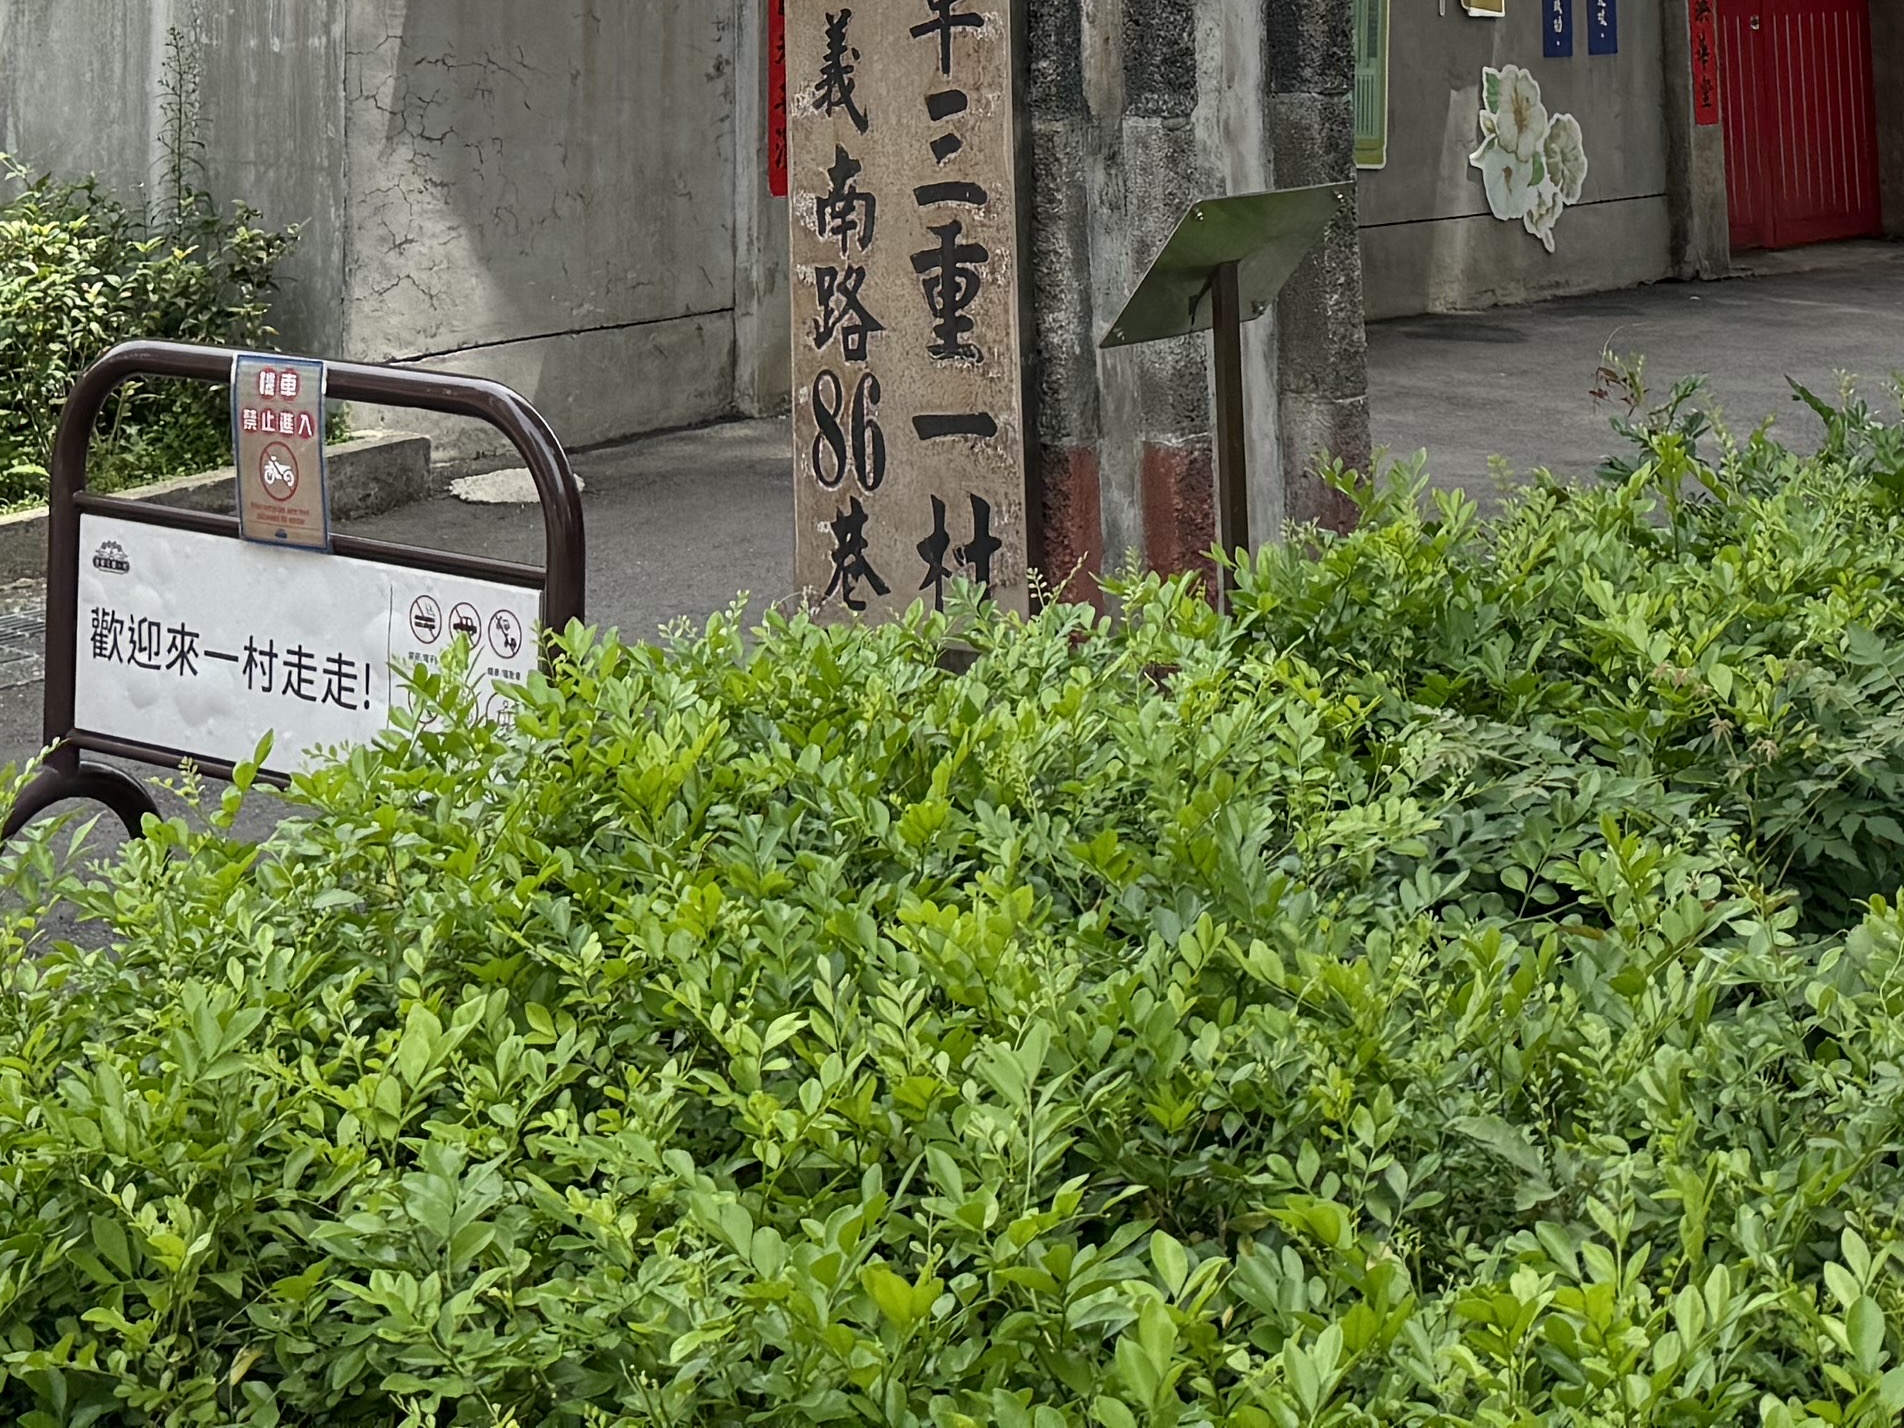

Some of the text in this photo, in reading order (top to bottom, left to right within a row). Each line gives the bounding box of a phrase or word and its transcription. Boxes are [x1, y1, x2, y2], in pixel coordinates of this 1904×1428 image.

[259, 370, 297, 396] 機車
[243, 408, 312, 437] 禁止進入
[90, 606, 371, 711] 歡迎來一村走走!
